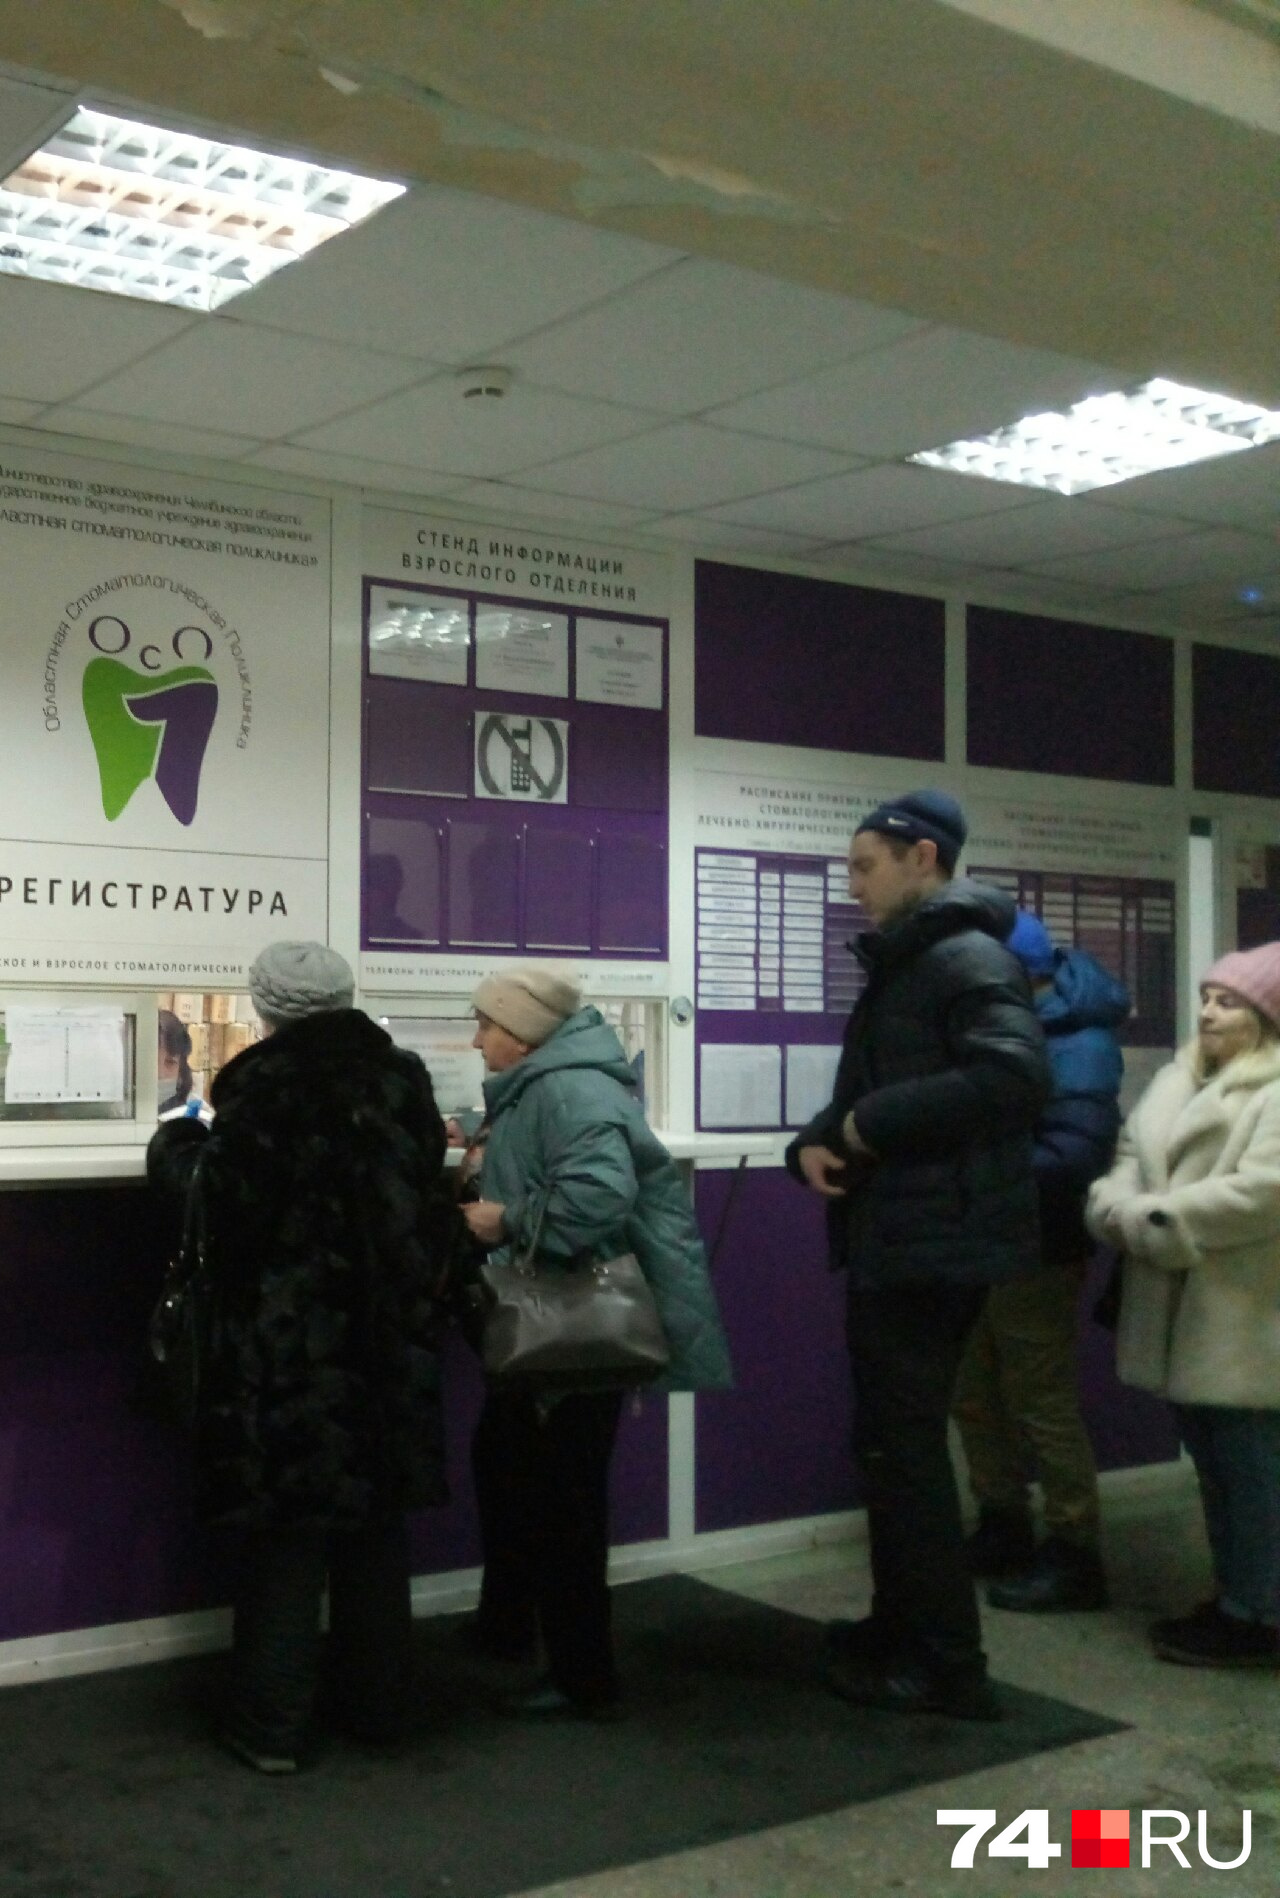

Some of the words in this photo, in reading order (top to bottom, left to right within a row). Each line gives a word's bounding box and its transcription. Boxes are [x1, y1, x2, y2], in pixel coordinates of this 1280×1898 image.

[417, 529, 479, 555] СТЕНД
[489, 541, 623, 575] ИНФОРМАЦИИ
[402, 553, 516, 584] ВЗРОСЛОГО
[529, 572, 637, 601] ОТДЕЛЕНИЯ
[32, 960, 40, 968] И
[46, 960, 109, 970] ВЗРОСЛОЕ
[114, 961, 243, 974] СТОМАТОЛОГИЧЕСКИЕ
